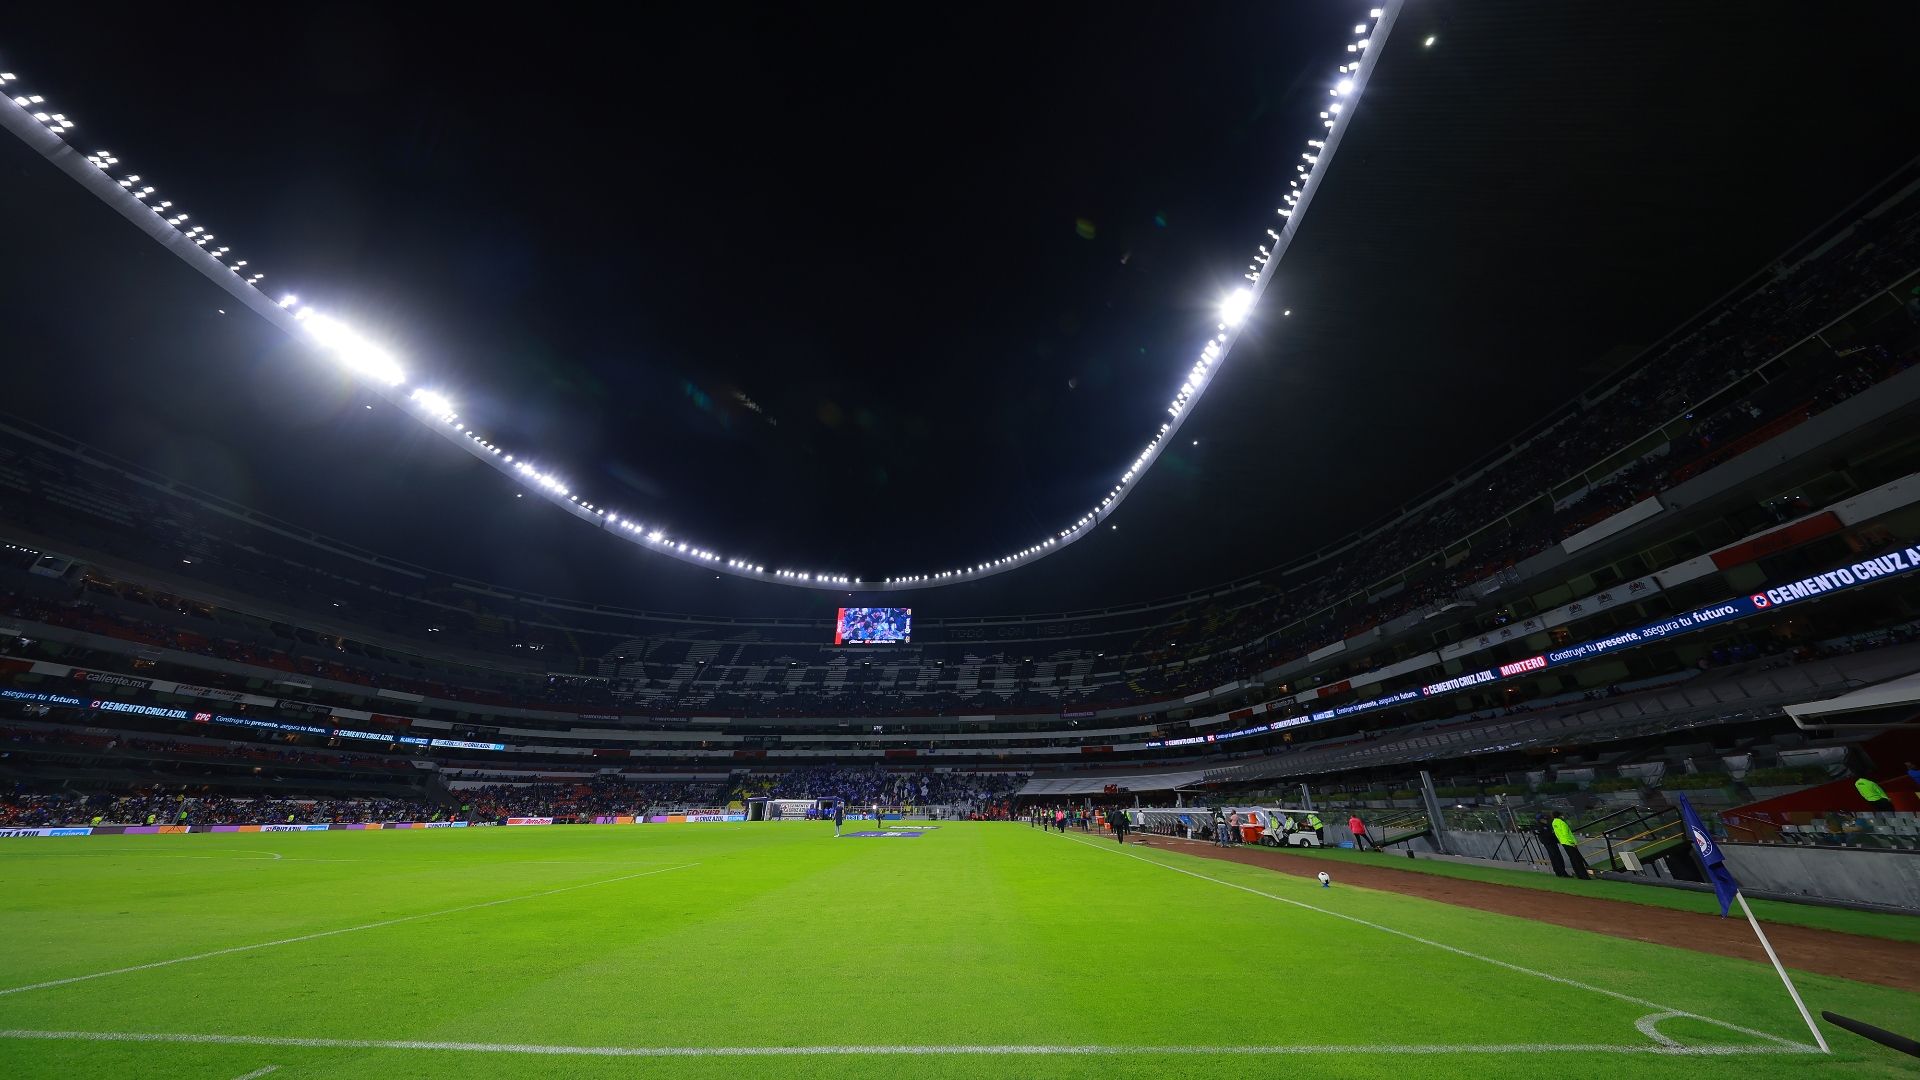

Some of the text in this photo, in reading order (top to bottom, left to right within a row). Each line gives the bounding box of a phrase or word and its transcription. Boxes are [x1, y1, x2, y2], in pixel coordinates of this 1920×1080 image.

[1767, 568, 1855, 605] CEMENTO
[1851, 552, 1910, 580] CRUZ
[1549, 603, 1739, 662] Construye tu presente, asegura tu futuro.
[1500, 656, 1546, 676] MORTERO
[1428, 670, 1496, 695] CEMENTO CRUZ AZUL
[1, 689, 37, 701] asegura
[48, 694, 80, 705] futuro.
[100, 701, 187, 719] CEMENTO CRUZ AZUL
[194, 712, 211, 721] CPC
[215, 715, 244, 725] Construye
[338, 730, 367, 740] CEMENTO
